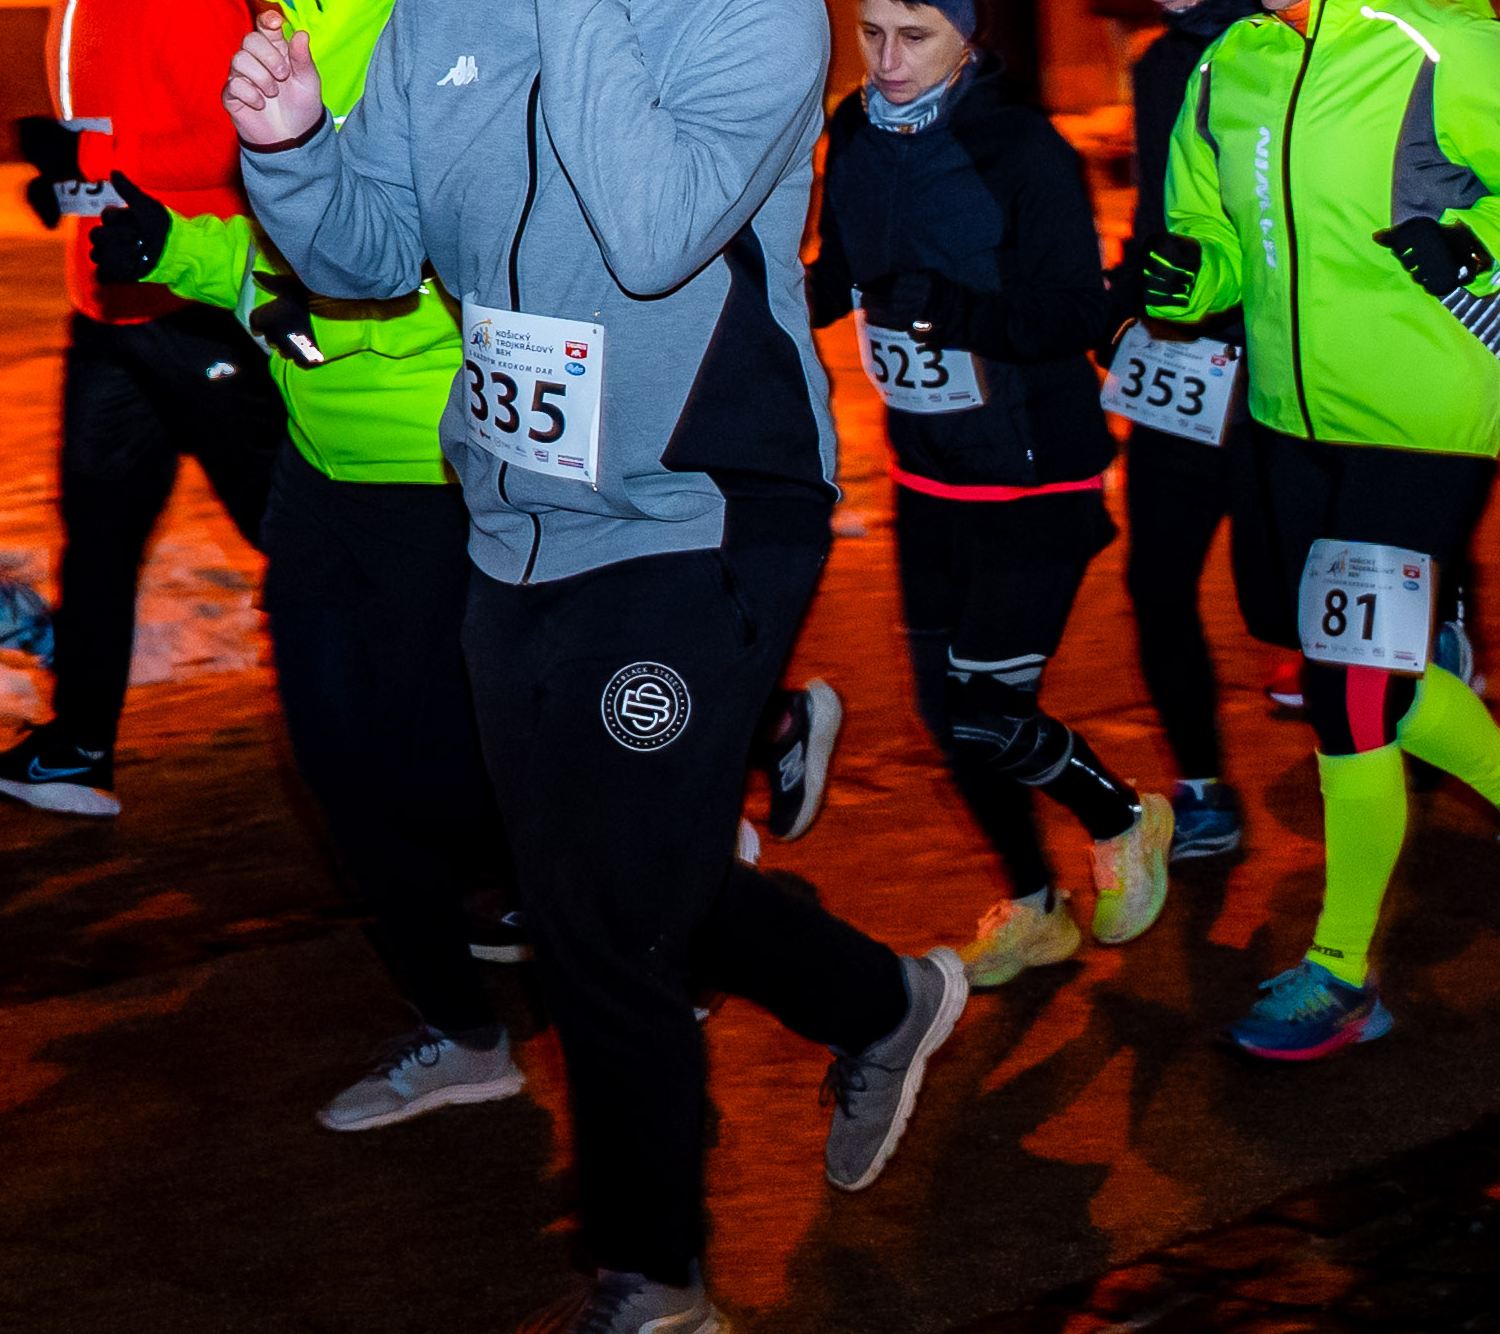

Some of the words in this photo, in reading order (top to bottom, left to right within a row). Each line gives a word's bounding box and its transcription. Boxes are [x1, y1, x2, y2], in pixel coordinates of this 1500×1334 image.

[869, 338, 949, 389] 523
[1121, 357, 1206, 416] 353
[465, 359, 567, 444] 335
[1322, 588, 1378, 641] 81
[620, 667, 648, 681] BLACK
